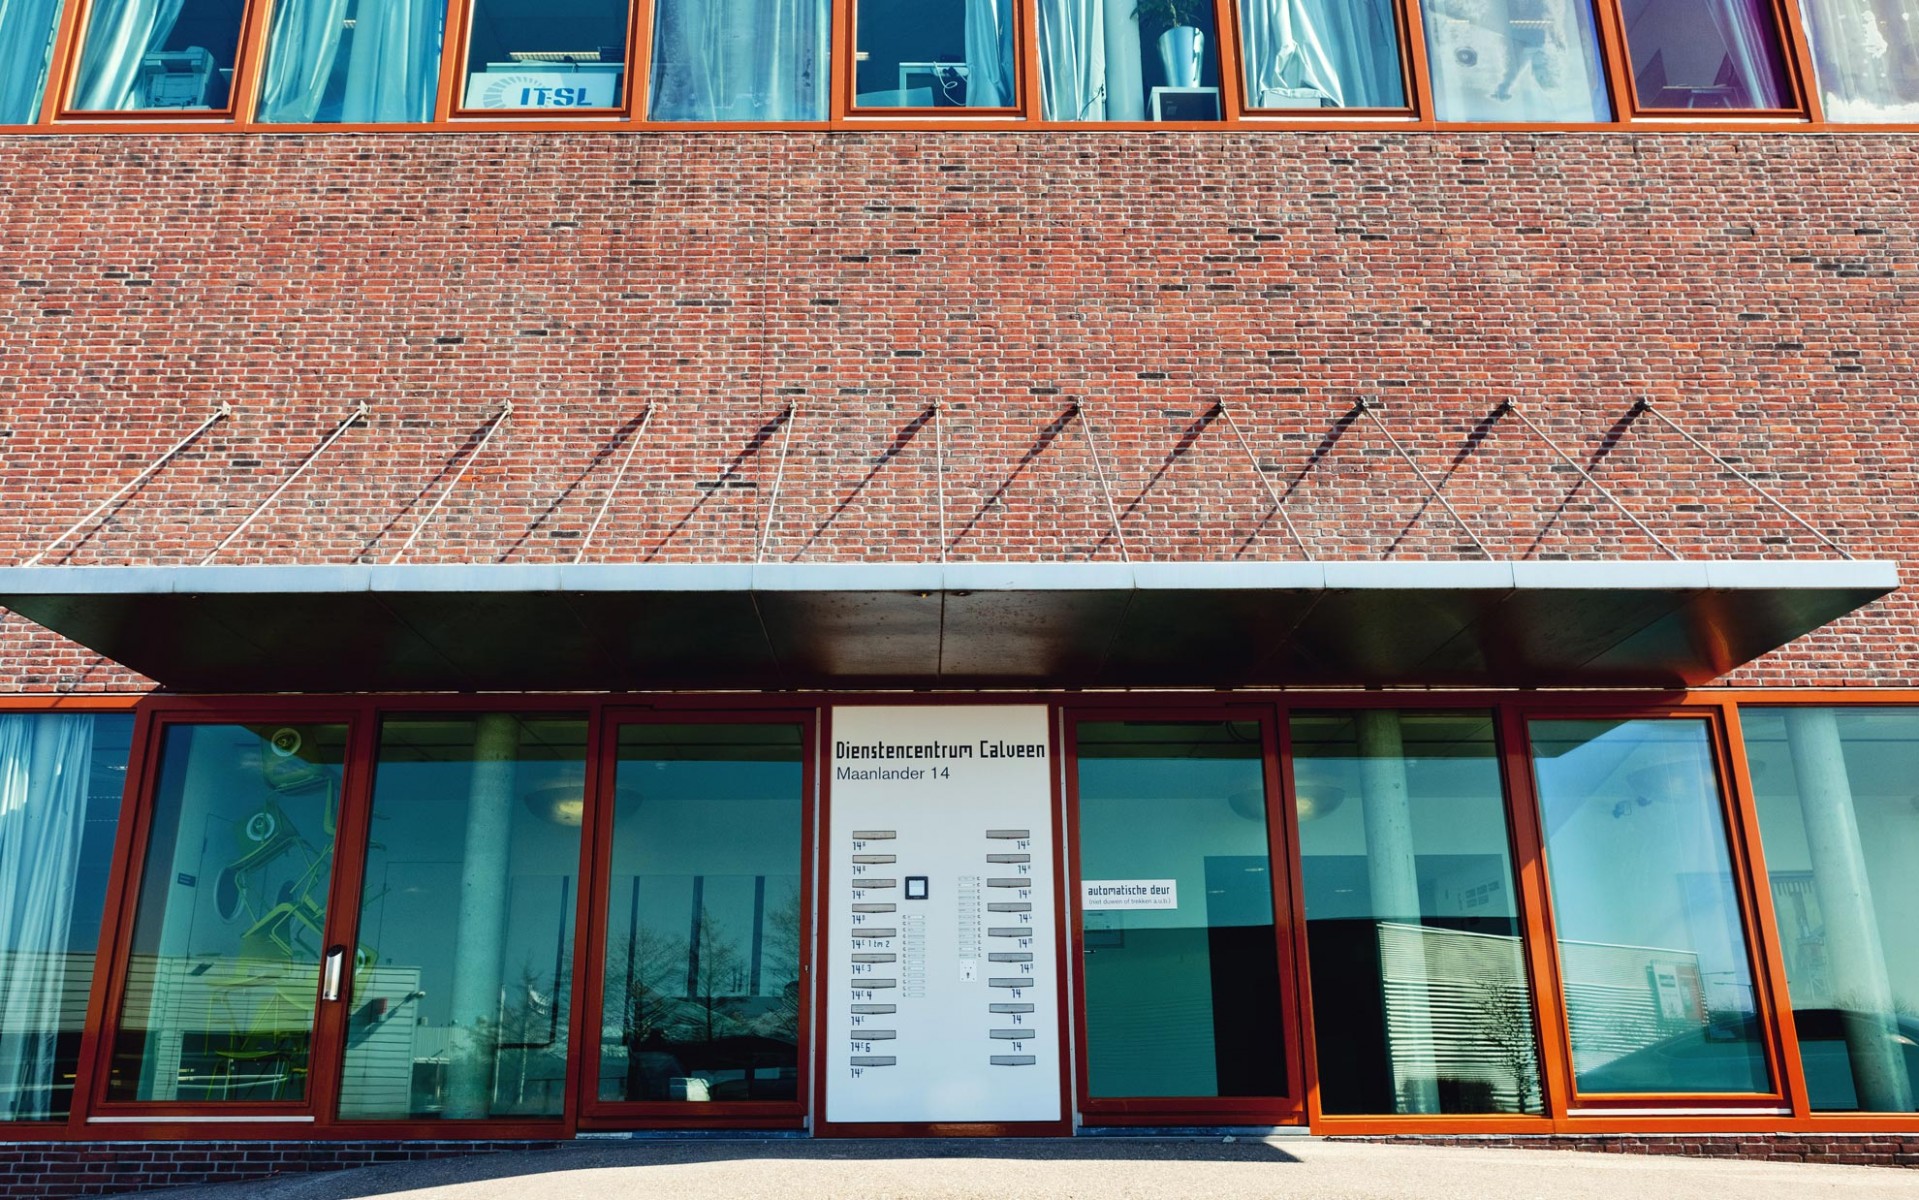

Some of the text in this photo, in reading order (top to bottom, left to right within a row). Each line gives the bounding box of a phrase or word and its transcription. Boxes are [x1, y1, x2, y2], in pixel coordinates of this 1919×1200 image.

[520, 87, 592, 106] ITSL
[836, 740, 1045, 759] Dienstencentrum Calveen
[836, 766, 950, 780] Maanlander 14
[1088, 885, 1170, 896] automatische deur
